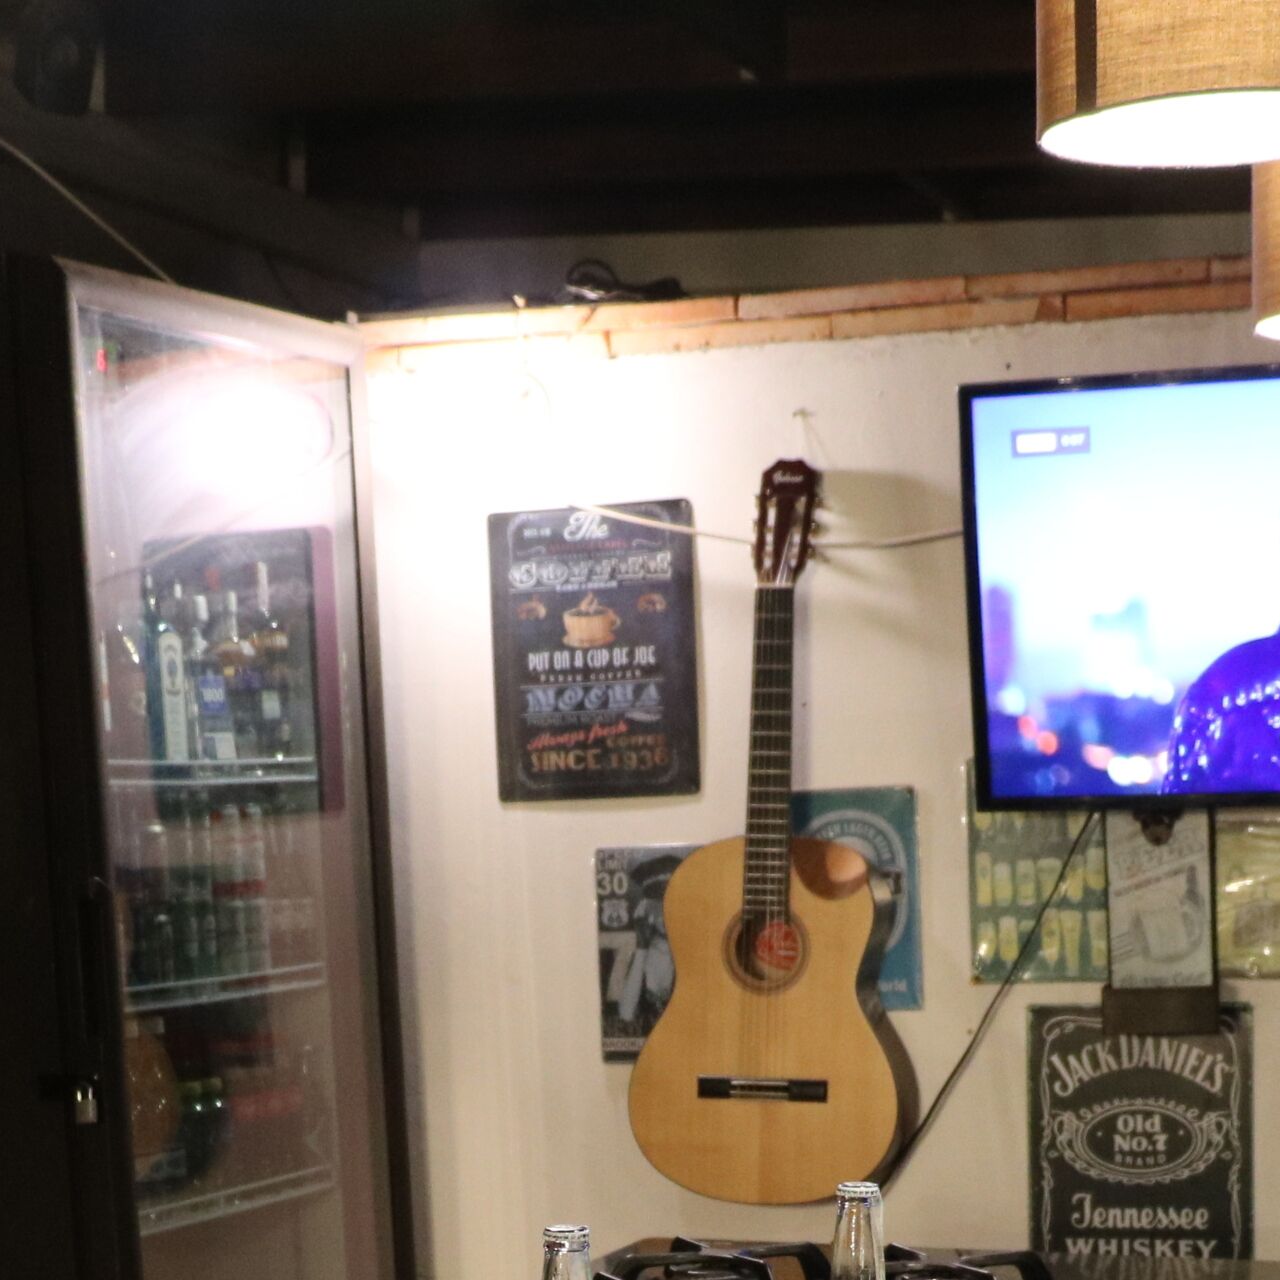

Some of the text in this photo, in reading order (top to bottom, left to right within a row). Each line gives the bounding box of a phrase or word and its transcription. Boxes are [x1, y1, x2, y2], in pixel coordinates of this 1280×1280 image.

[562, 511, 609, 542] The
[528, 645, 656, 671] PUT ON A CUP OF JOE
[526, 683, 660, 713] MOCHA
[530, 749, 603, 773] SINCE
[597, 871, 629, 896] 30
[1050, 1034, 1230, 1097] JACK DANIEL'S
[1116, 1113, 1161, 1134] Old
[1071, 1192, 1209, 1230] Tennessee
[1064, 1237, 1218, 1261] WHISKEY
